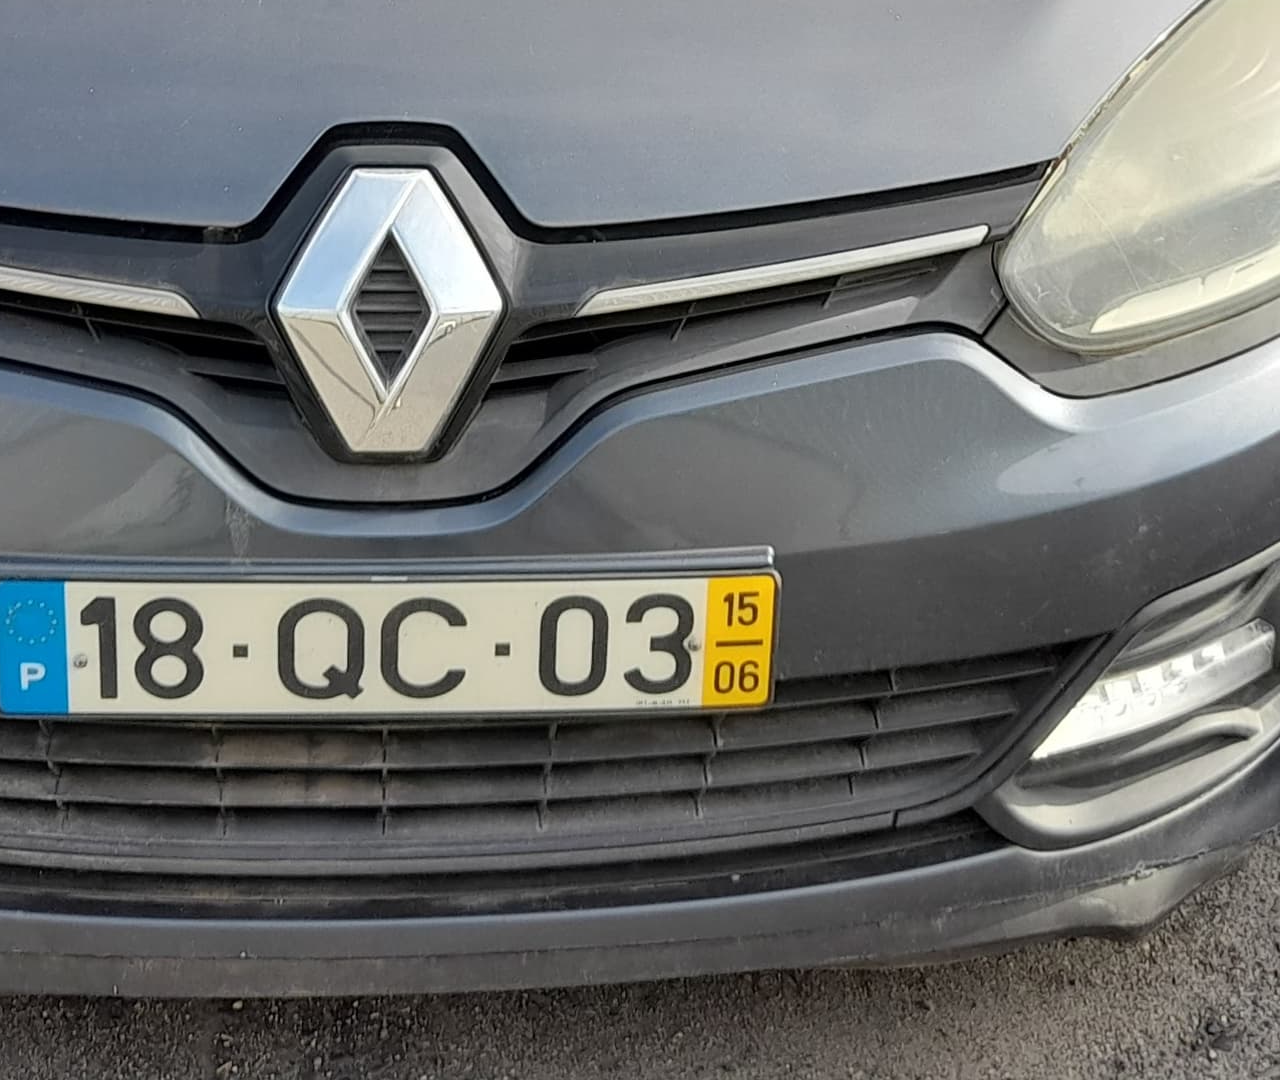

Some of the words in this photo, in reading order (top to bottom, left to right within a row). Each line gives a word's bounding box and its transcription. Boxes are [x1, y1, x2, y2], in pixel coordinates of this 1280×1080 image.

[722, 591, 760, 627] 15
[19, 662, 46, 691] P
[713, 660, 760, 694] 06
